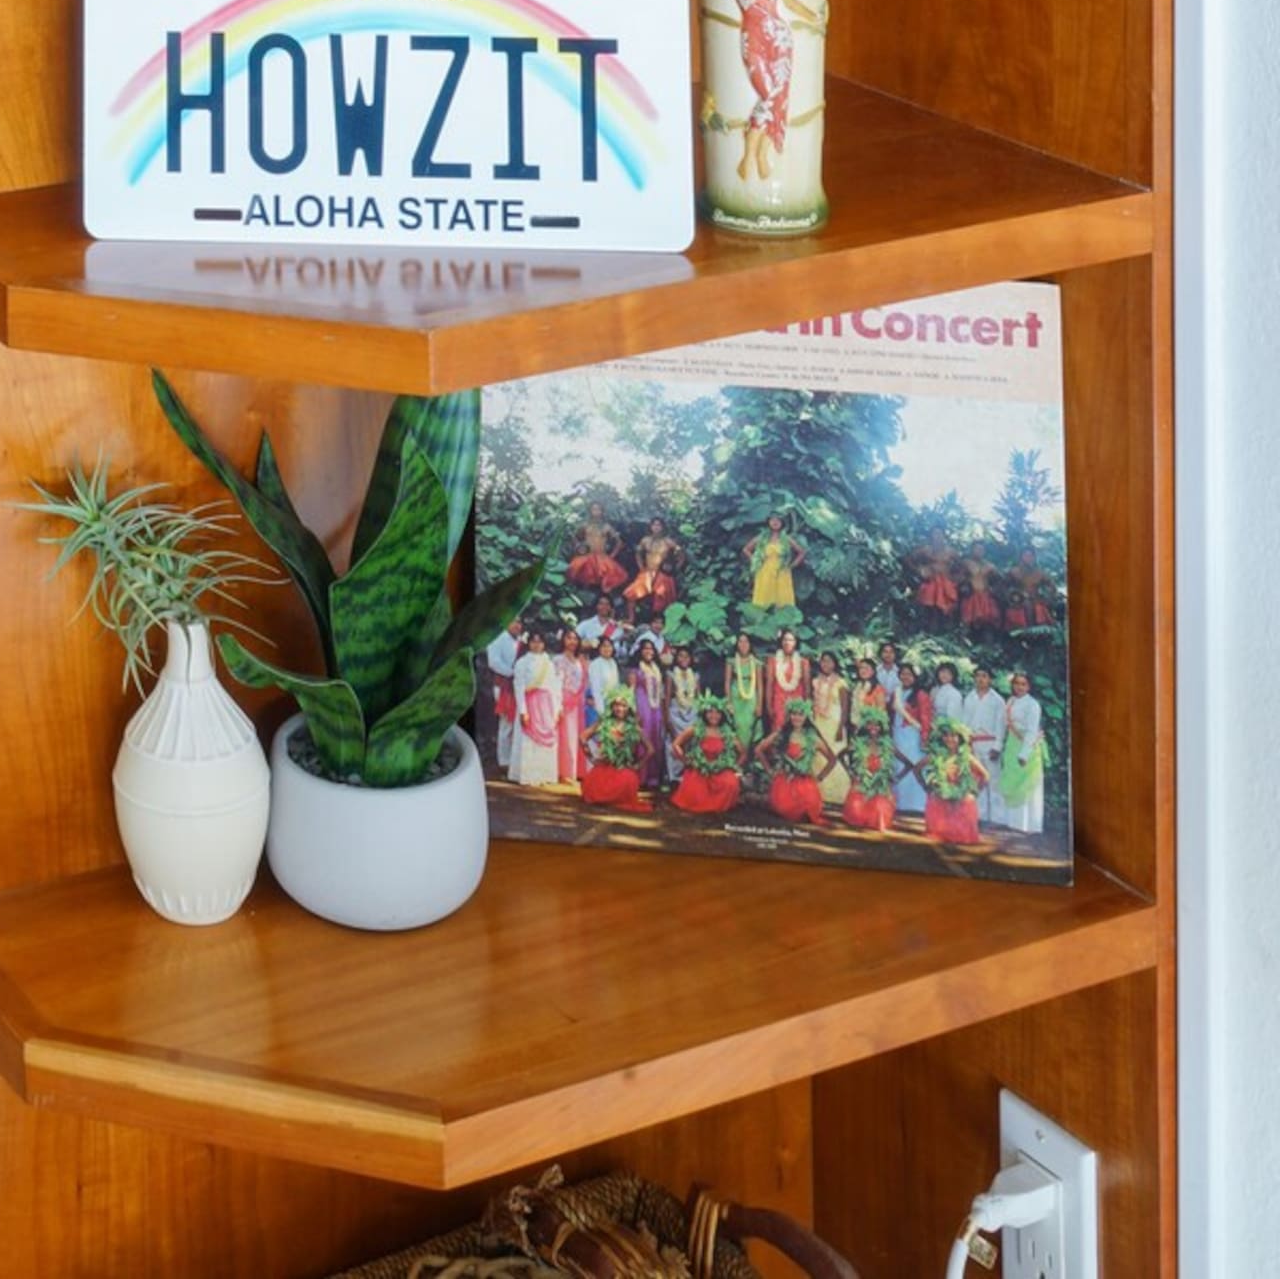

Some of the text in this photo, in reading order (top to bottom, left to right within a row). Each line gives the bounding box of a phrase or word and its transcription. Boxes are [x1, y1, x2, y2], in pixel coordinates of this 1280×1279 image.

[166, 31, 618, 182] HOWZIT
[243, 194, 526, 232] ALOHA STATE
[851, 306, 1043, 349] Concert
